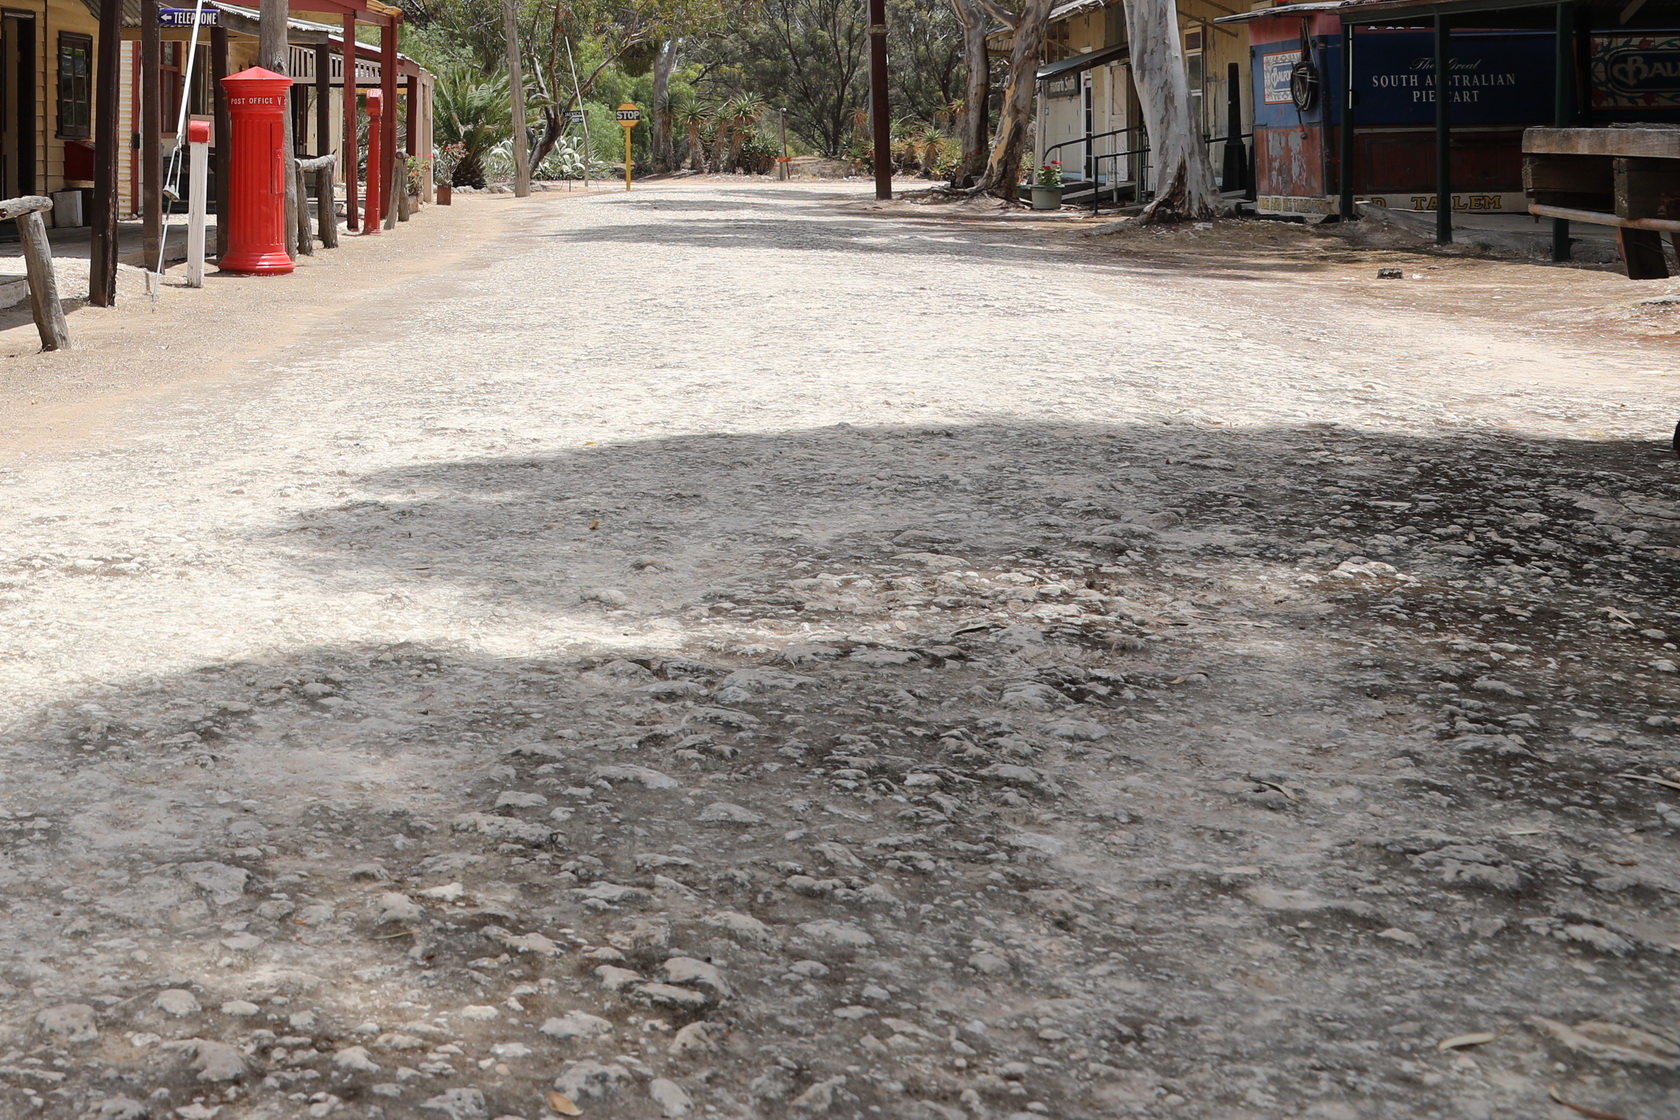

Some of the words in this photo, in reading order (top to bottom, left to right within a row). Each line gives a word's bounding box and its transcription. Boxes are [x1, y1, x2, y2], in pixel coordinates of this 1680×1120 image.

[174, 12, 217, 25] TELEPONE
[1409, 57, 1435, 71] The
[1612, 55, 1680, 87] BAL
[1271, 67, 1293, 88] BALFO
[1372, 74, 1419, 88] SOUTH
[1425, 73, 1516, 87] ATRALIAN
[230, 97, 245, 105] POST
[1412, 90, 1436, 103] PIE
[1448, 90, 1479, 103] ART
[616, 110, 640, 120] STOP
[1411, 195, 1502, 210] TALEM
